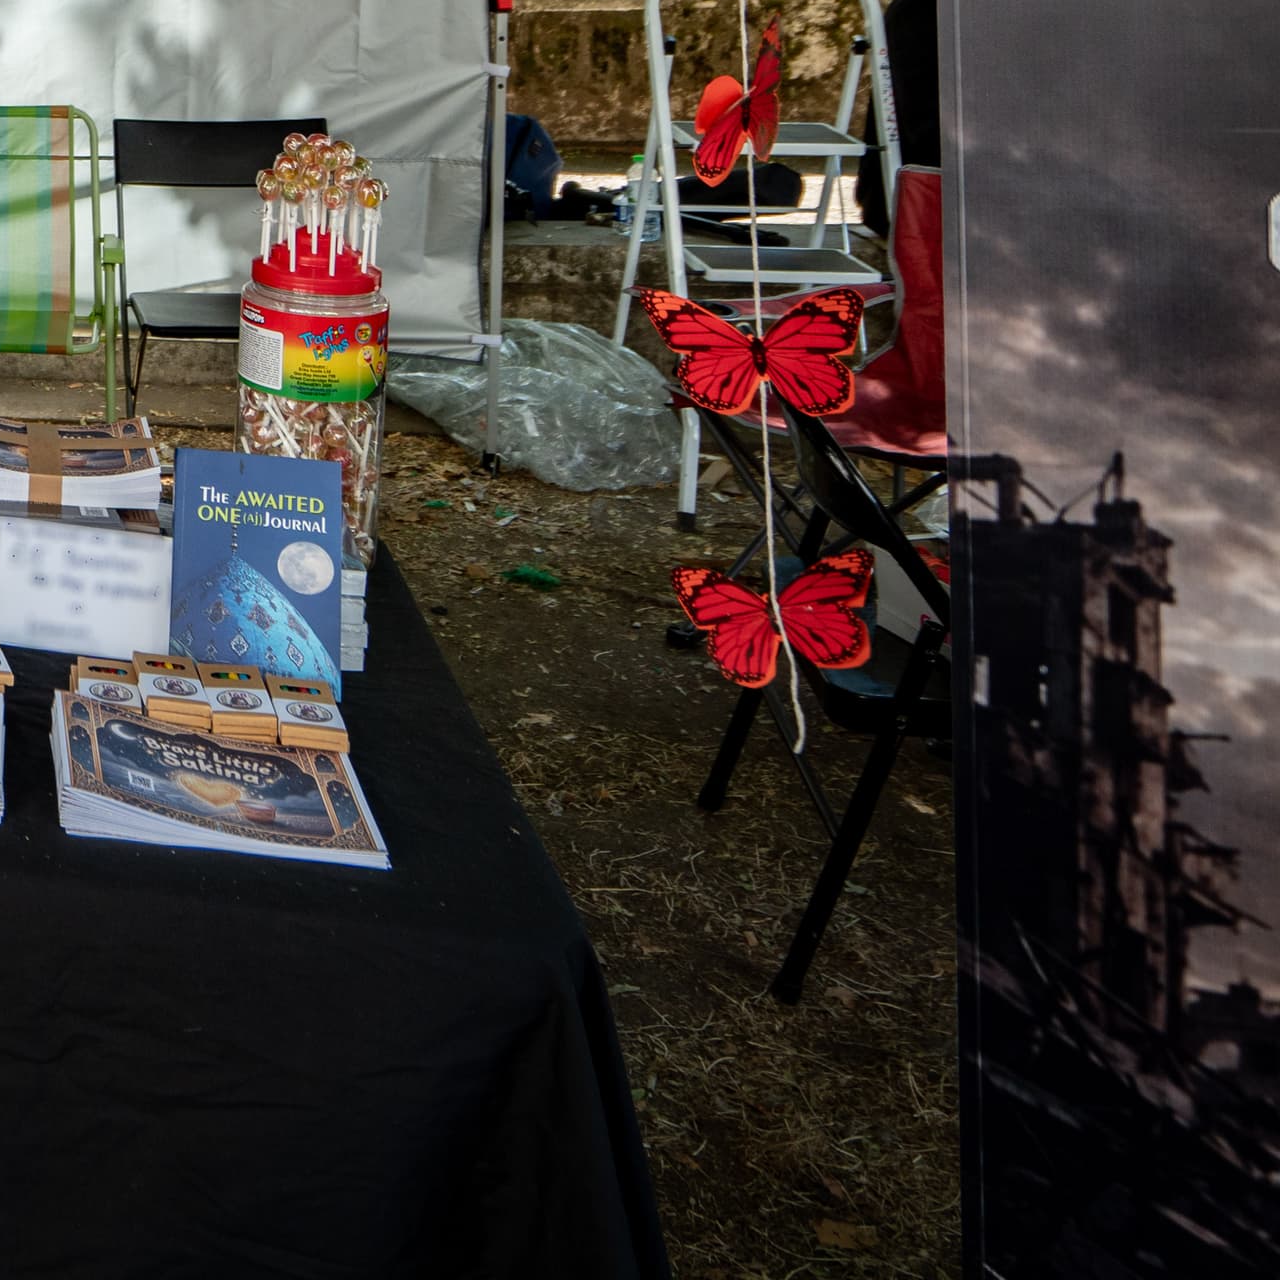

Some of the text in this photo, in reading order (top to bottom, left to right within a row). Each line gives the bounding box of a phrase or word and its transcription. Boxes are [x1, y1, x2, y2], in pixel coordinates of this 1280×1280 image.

[197, 505, 241, 524] ONE
[200, 486, 325, 514] The AWAITED
[143, 735, 272, 775] Brave Little
[161, 750, 261, 785] Sakina
